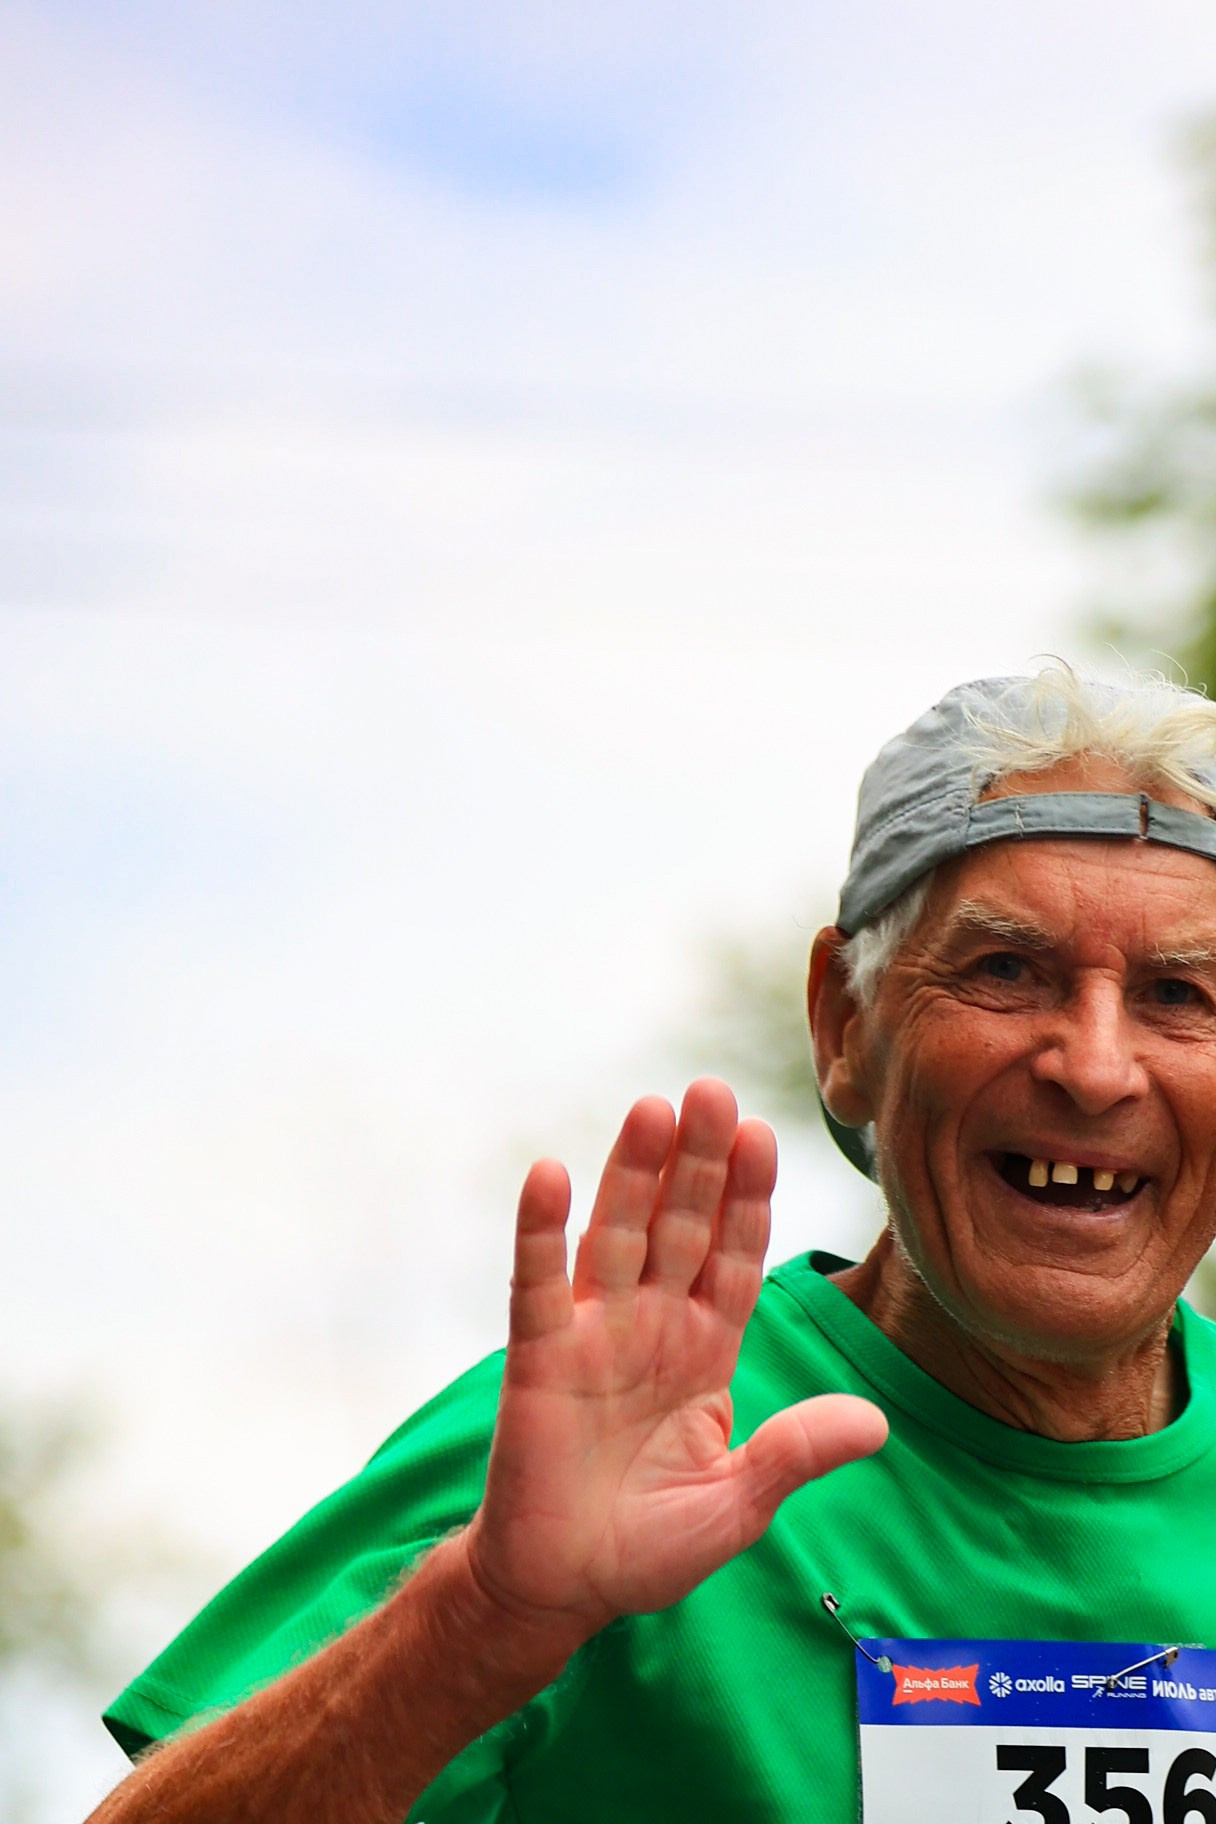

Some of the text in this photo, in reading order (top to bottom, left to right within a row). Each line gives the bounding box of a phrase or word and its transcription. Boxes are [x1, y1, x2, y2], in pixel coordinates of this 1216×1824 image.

[903, 1677, 969, 1693] Альфа Банк
[1015, 1676, 1066, 1693] axolla
[1071, 1675, 1147, 1690] SPNE
[1152, 1680, 1197, 1700] ИЮЛЬ
